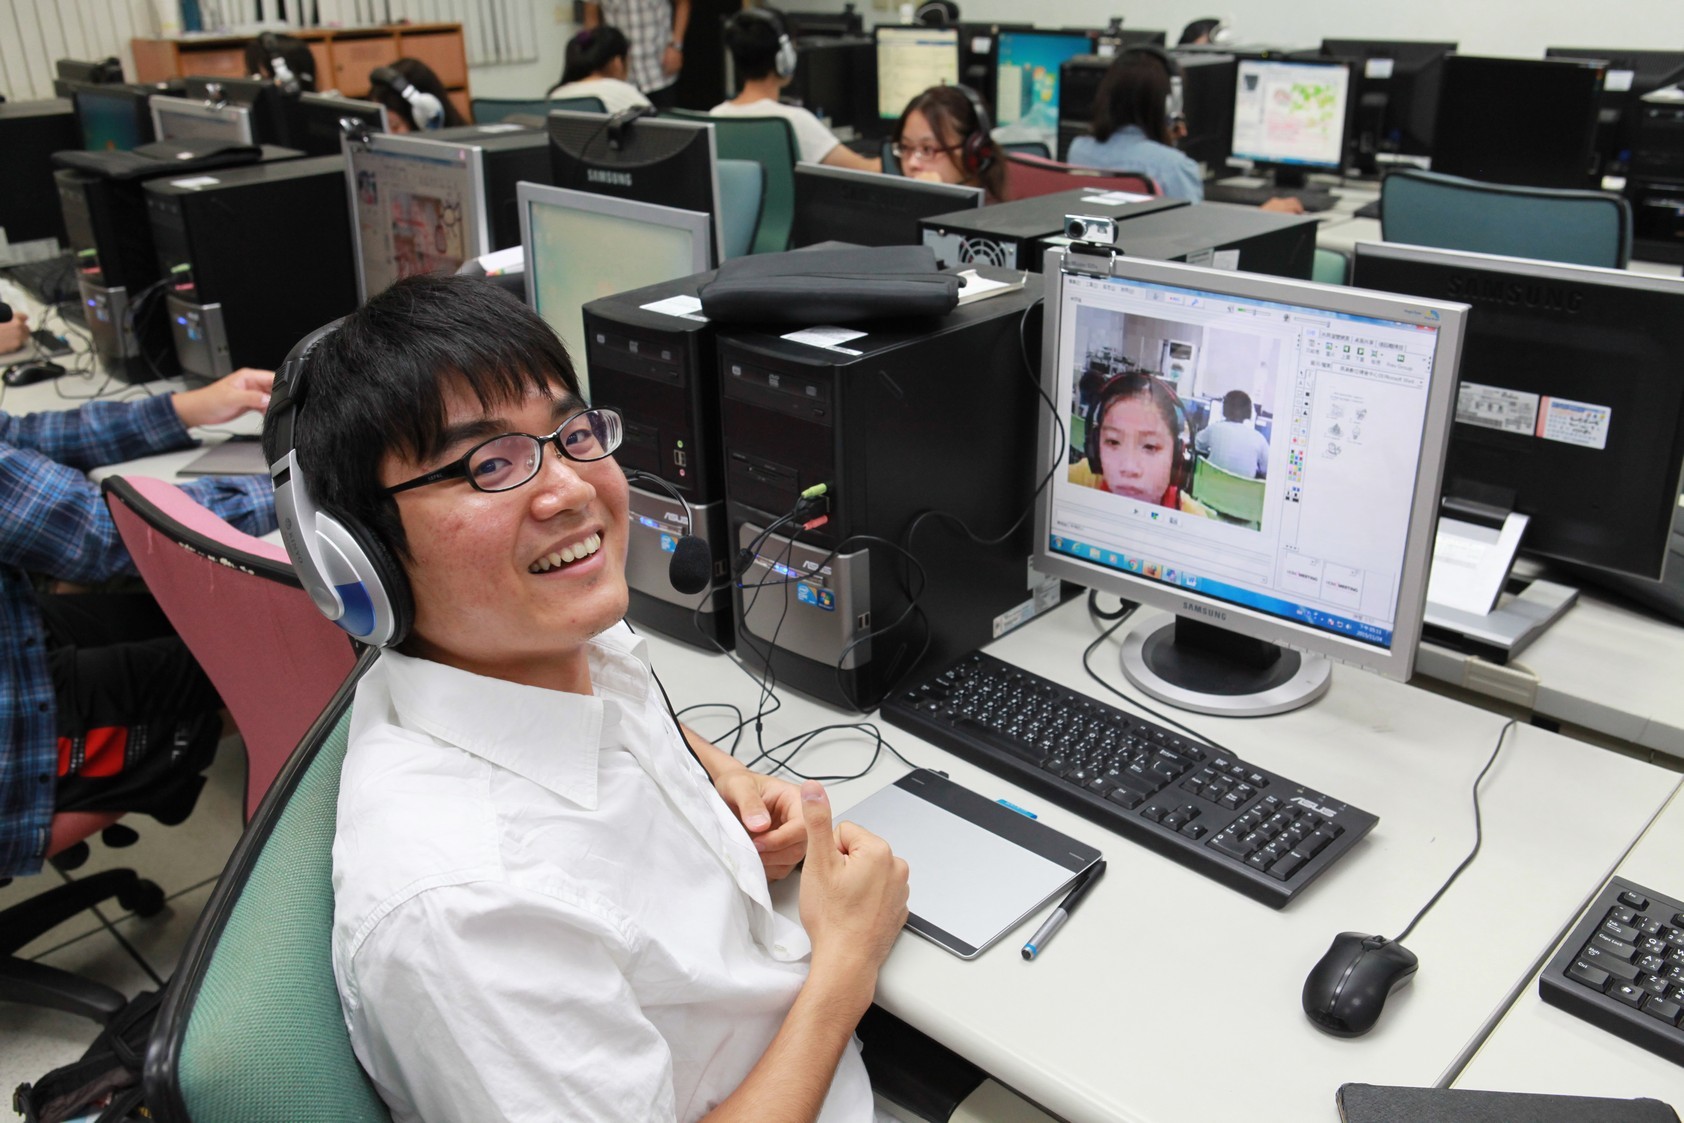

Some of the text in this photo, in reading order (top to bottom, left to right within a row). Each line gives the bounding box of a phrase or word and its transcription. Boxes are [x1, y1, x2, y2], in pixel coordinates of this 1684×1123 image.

[587, 169, 632, 186] SAMSUNG
[1448, 275, 1583, 314] SAMSUNG
[1182, 601, 1227, 621] SAMSUNG
[1289, 796, 1338, 818] ASUS
